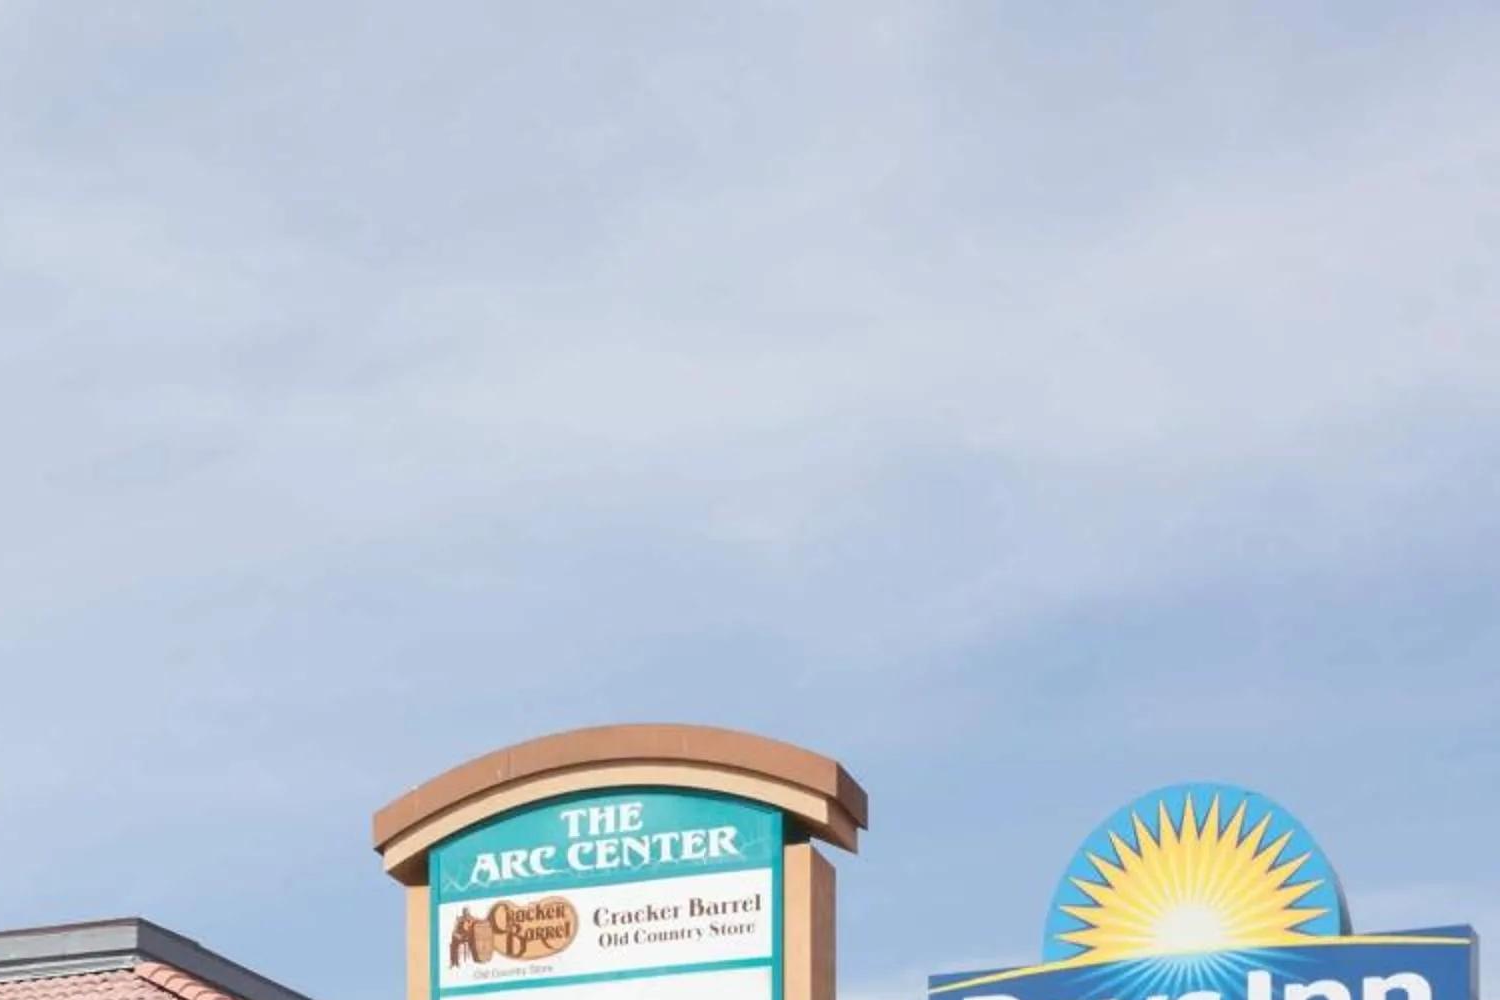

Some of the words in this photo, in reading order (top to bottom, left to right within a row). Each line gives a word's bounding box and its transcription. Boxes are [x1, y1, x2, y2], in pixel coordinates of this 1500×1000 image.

[560, 802, 643, 838] THE
[470, 846, 557, 884] ARC
[567, 826, 741, 872] CENTER
[593, 904, 682, 928] Cracker
[689, 894, 762, 918] Barrel
[598, 931, 629, 949] Old
[633, 927, 705, 946] Country
[709, 921, 756, 937] Store
